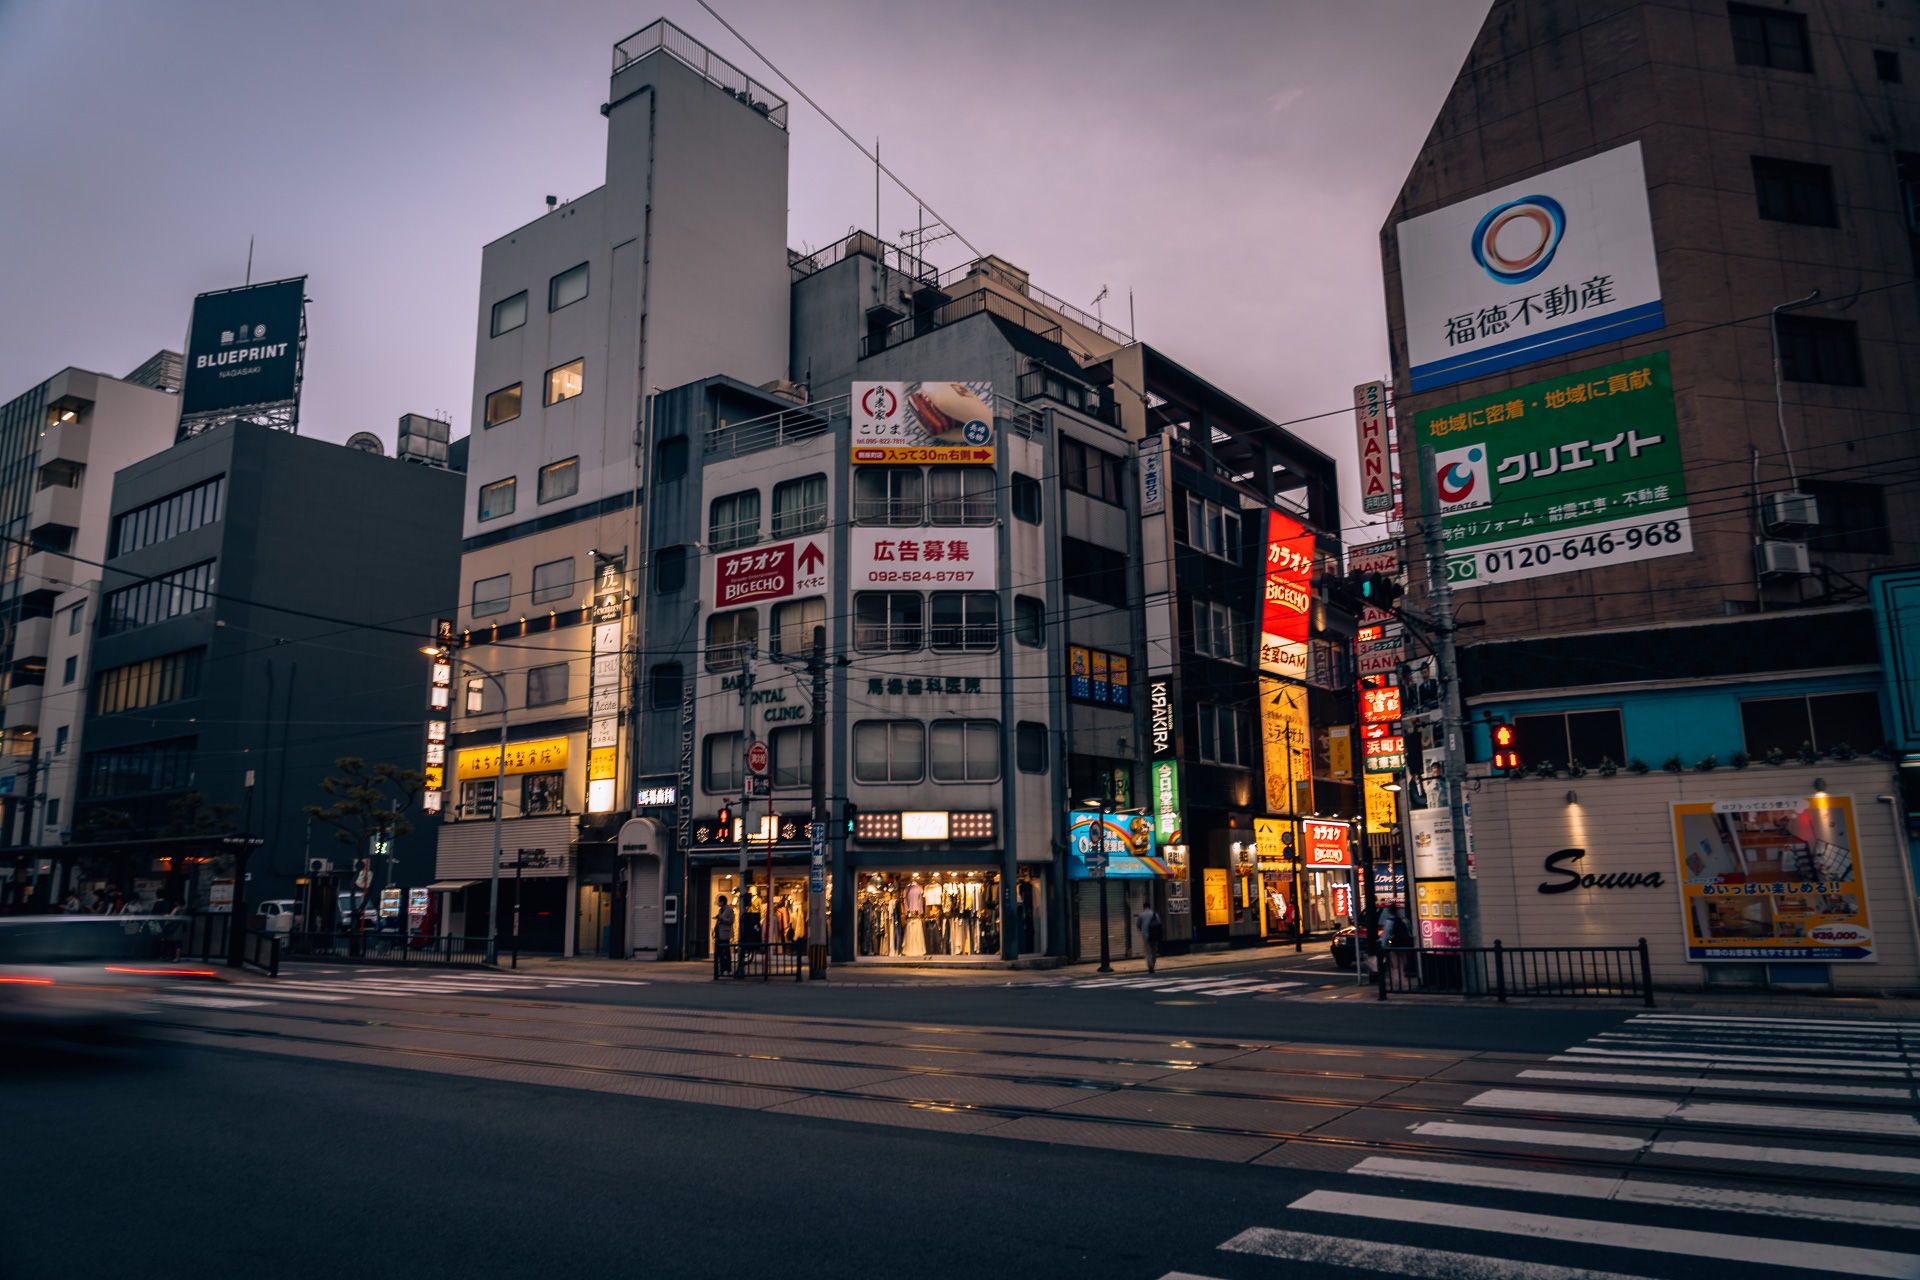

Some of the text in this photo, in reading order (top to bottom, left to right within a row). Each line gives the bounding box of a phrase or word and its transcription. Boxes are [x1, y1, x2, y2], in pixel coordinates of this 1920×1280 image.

[1444, 274, 1617, 347] 福徳不動産
[196, 343, 288, 368] BLUEPRINT
[219, 366, 262, 378] NAGASAKI
[874, 384, 886, 421] 角煮家
[1366, 385, 1380, 418] カラオケ
[1429, 368, 1653, 437] 地域に密着・地域に貢献
[860, 423, 902, 435] こじま
[888, 449, 971, 461] 入って30m右側
[1362, 418, 1385, 496] HANA
[1496, 429, 1666, 484] クリエイト
[873, 540, 969, 562] 広告募集
[1268, 542, 1313, 575] カラオケ
[1485, 521, 1682, 574] 0120-646-968
[725, 550, 786, 576] カラオケ
[796, 576, 825, 590] すぐそこ
[868, 571, 974, 582] 092-524-8787
[1361, 655, 1402, 671] HANA
[867, 677, 981, 696] 馬場歯科医院
[764, 705, 805, 723] CLINIC
[471, 748, 552, 770] はちの森整骨院
[678, 685, 694, 847] BABA DENTAL CLINIC
[1313, 825, 1341, 841] カラオケ
[1537, 848, 1665, 894] Souwa
[1336, 888, 1345, 913] カラオケ
